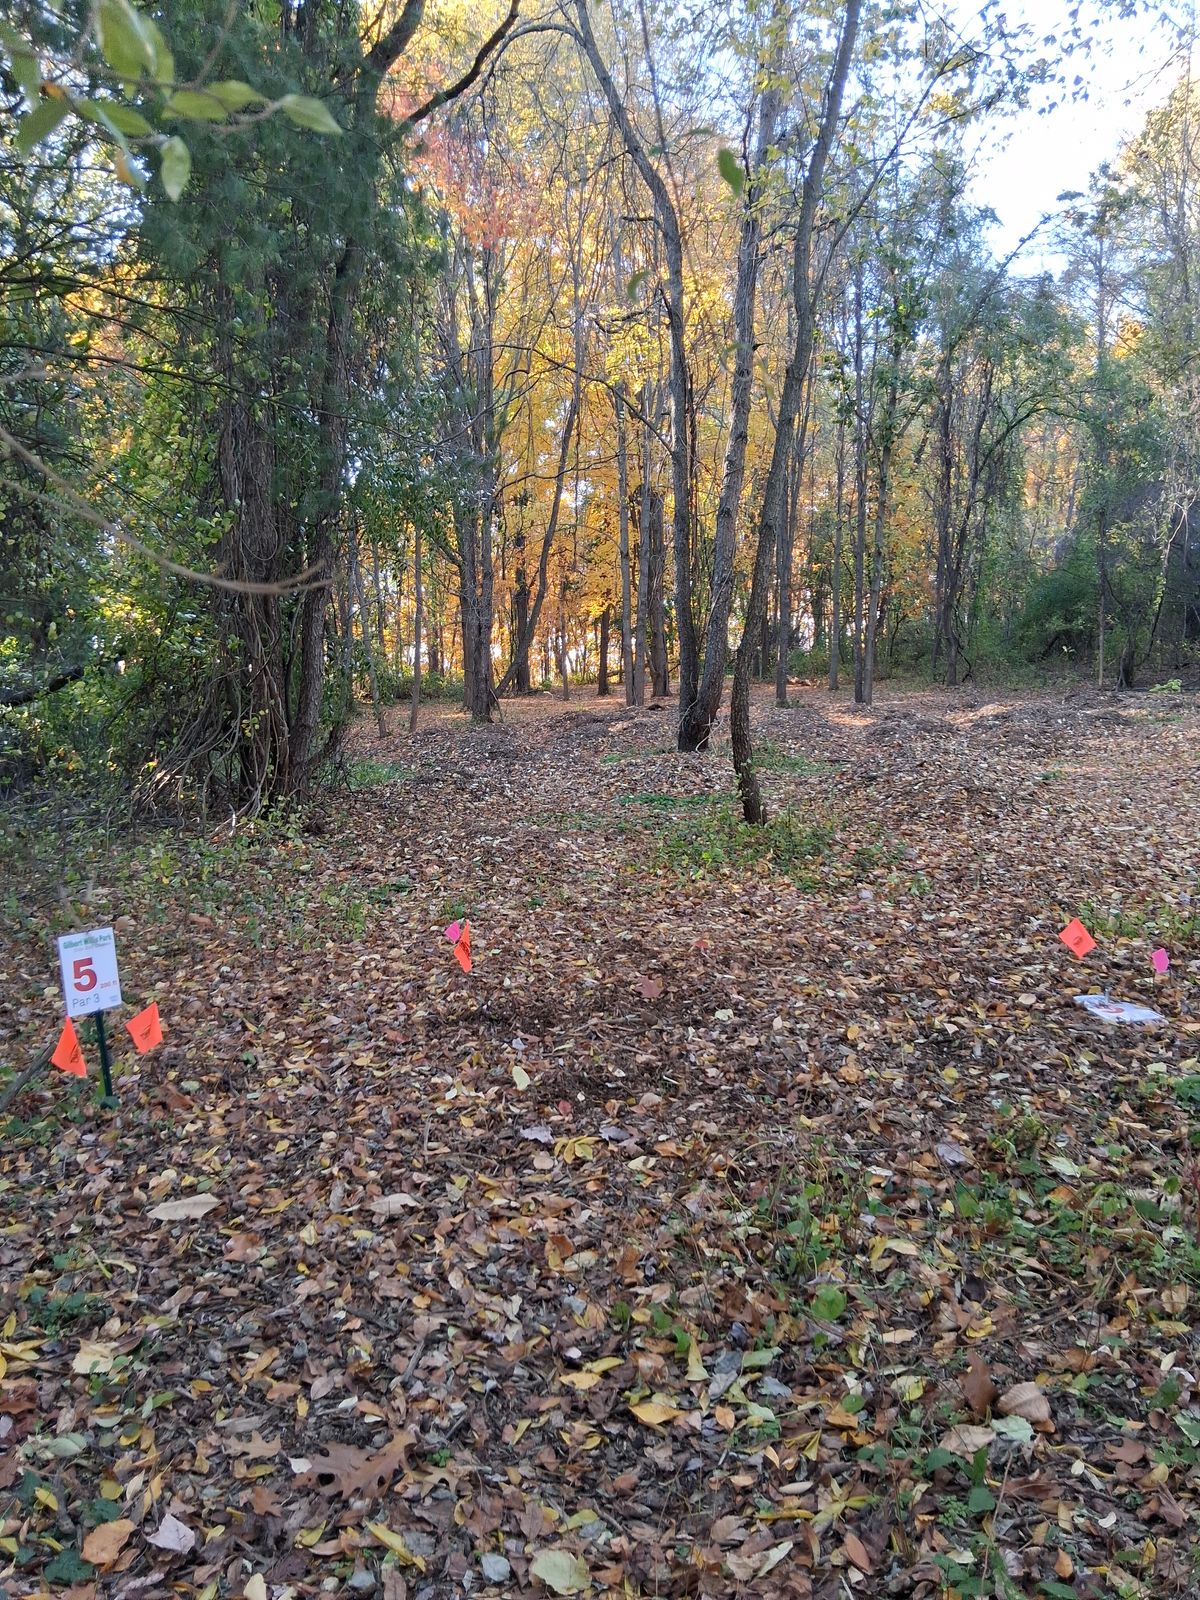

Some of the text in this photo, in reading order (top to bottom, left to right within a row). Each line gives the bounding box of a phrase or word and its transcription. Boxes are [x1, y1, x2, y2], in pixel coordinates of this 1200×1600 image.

[73, 957, 97, 992] 5
[72, 997, 91, 1009] Par
[93, 993, 100, 1004] 3
